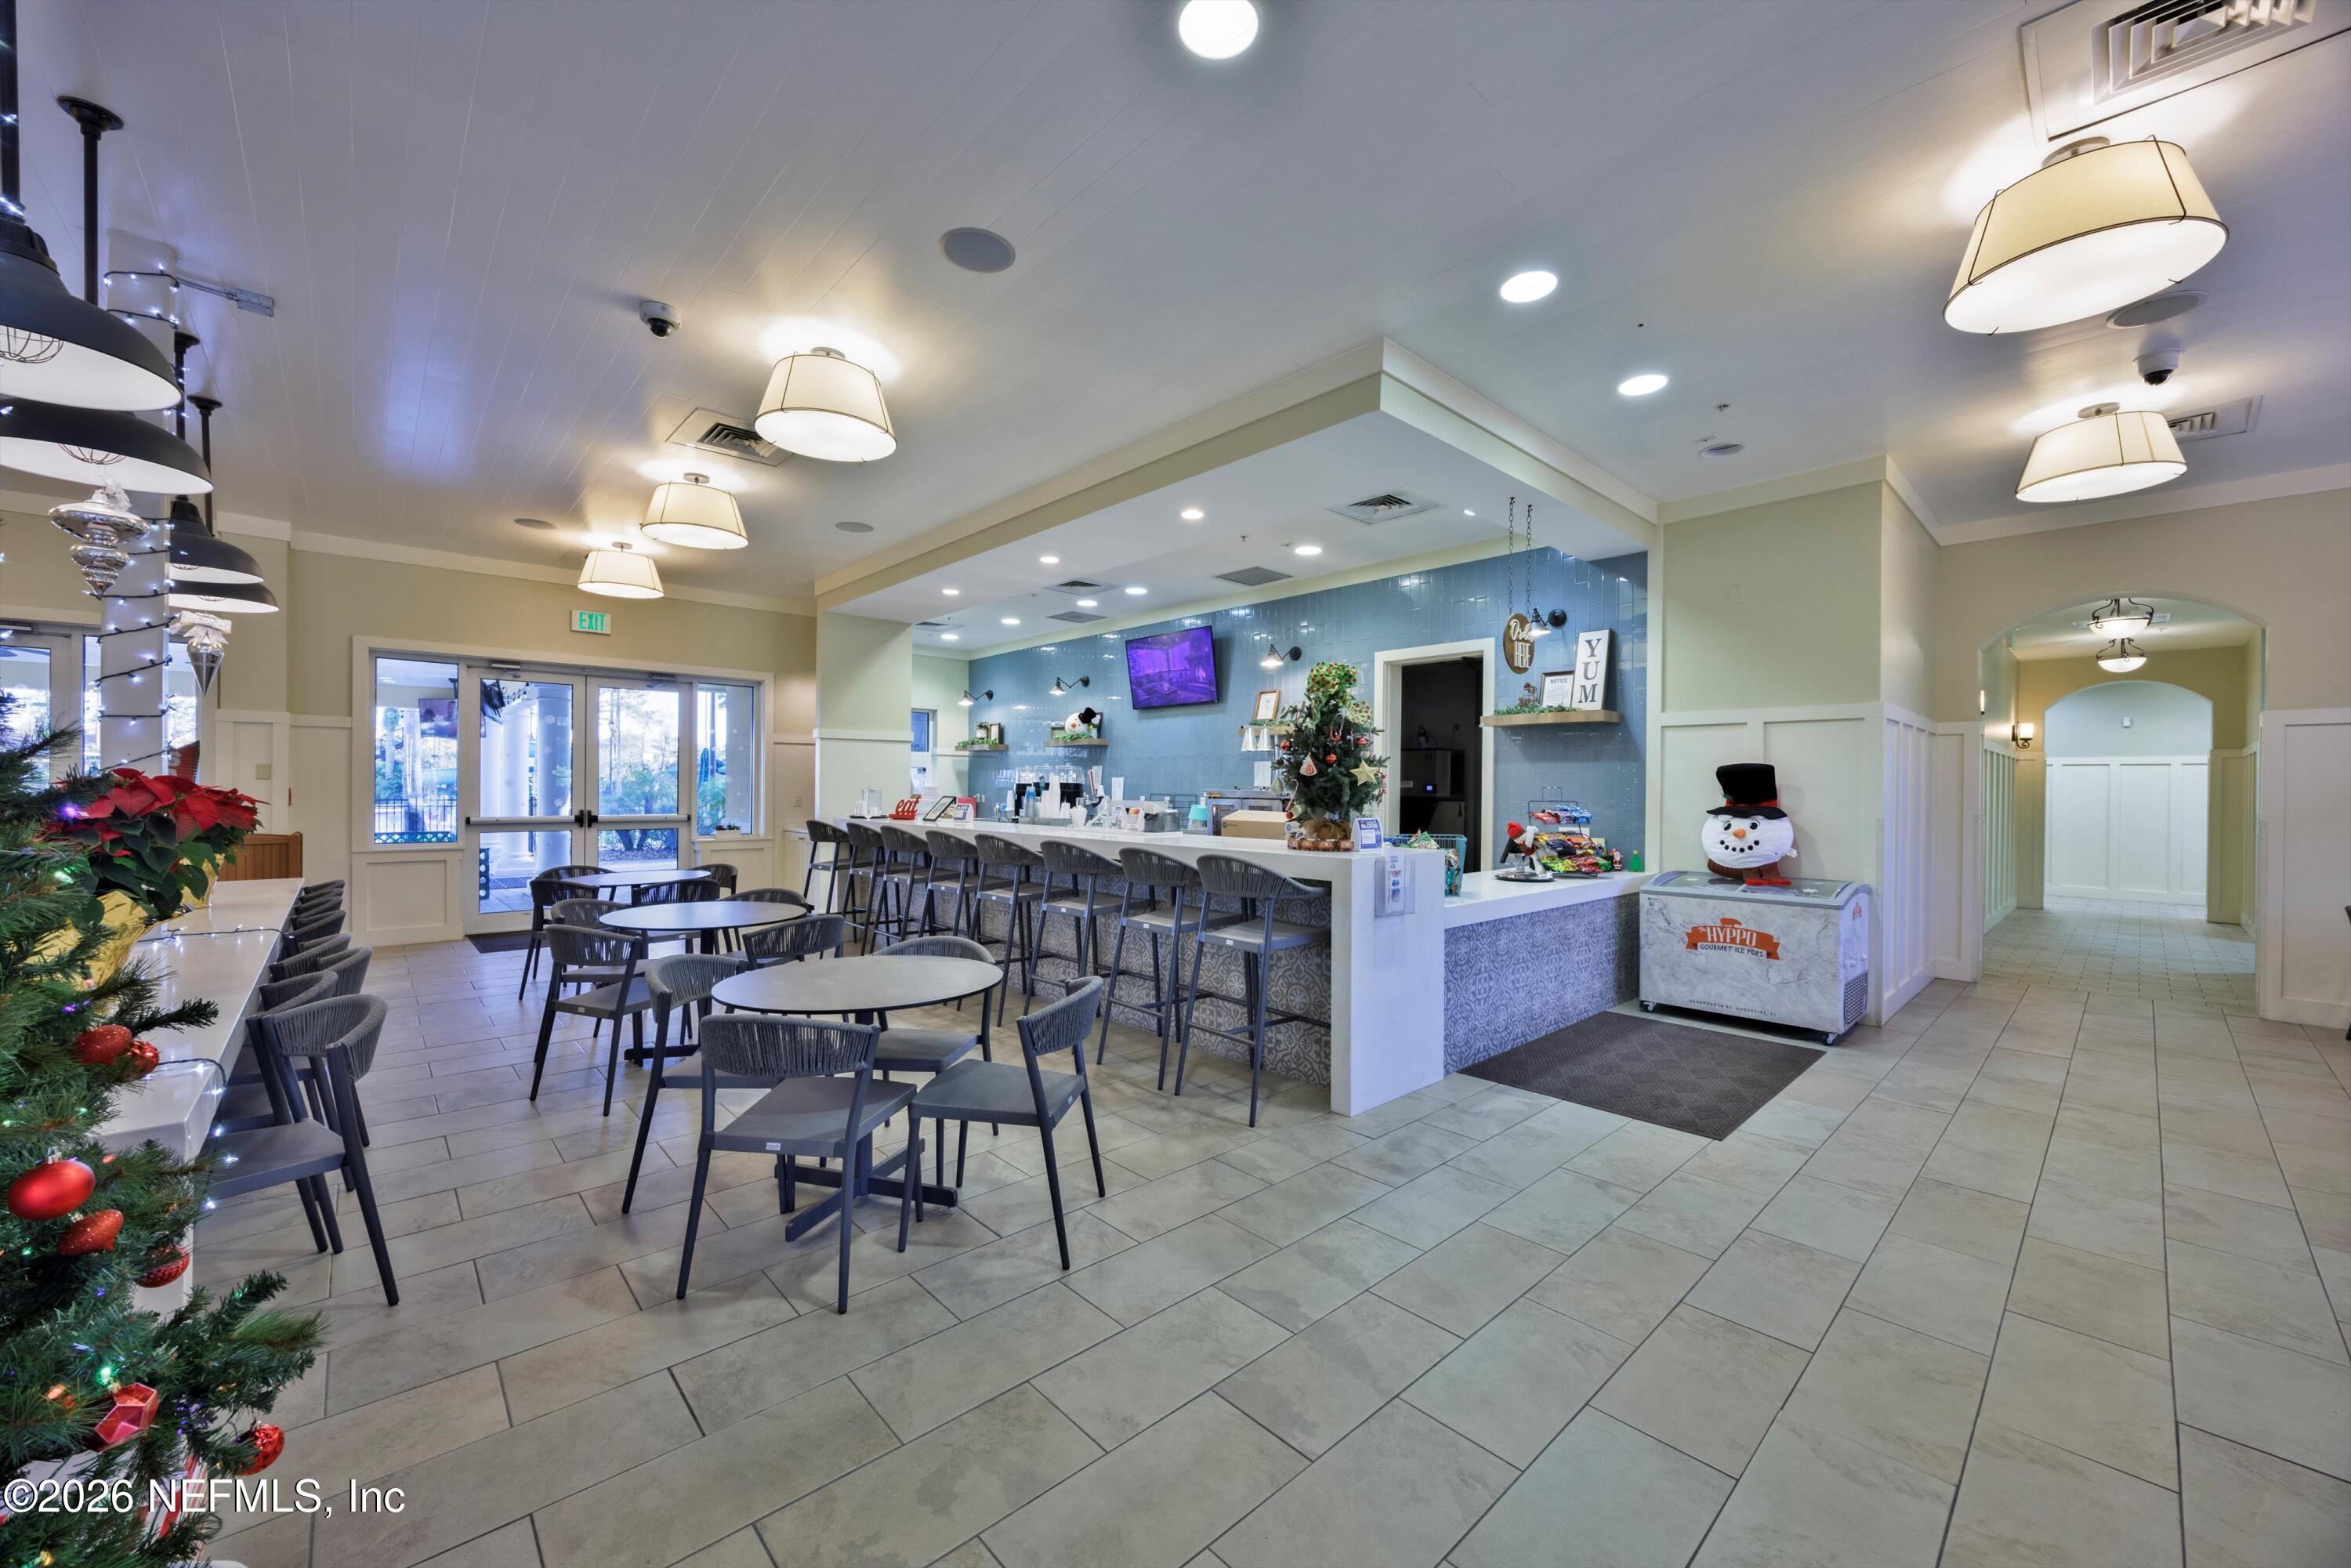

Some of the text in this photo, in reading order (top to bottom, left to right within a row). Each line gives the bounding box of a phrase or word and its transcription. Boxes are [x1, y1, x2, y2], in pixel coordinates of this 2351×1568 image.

[578, 611, 605, 632] EXIT
[1513, 641, 1531, 668] HERE
[1578, 639, 1603, 703] YUM
[895, 796, 920, 815] eat
[1707, 926, 1757, 947] HYPPO
[1700, 943, 1733, 952] GOURMET
[1747, 948, 1763, 958] POPS
